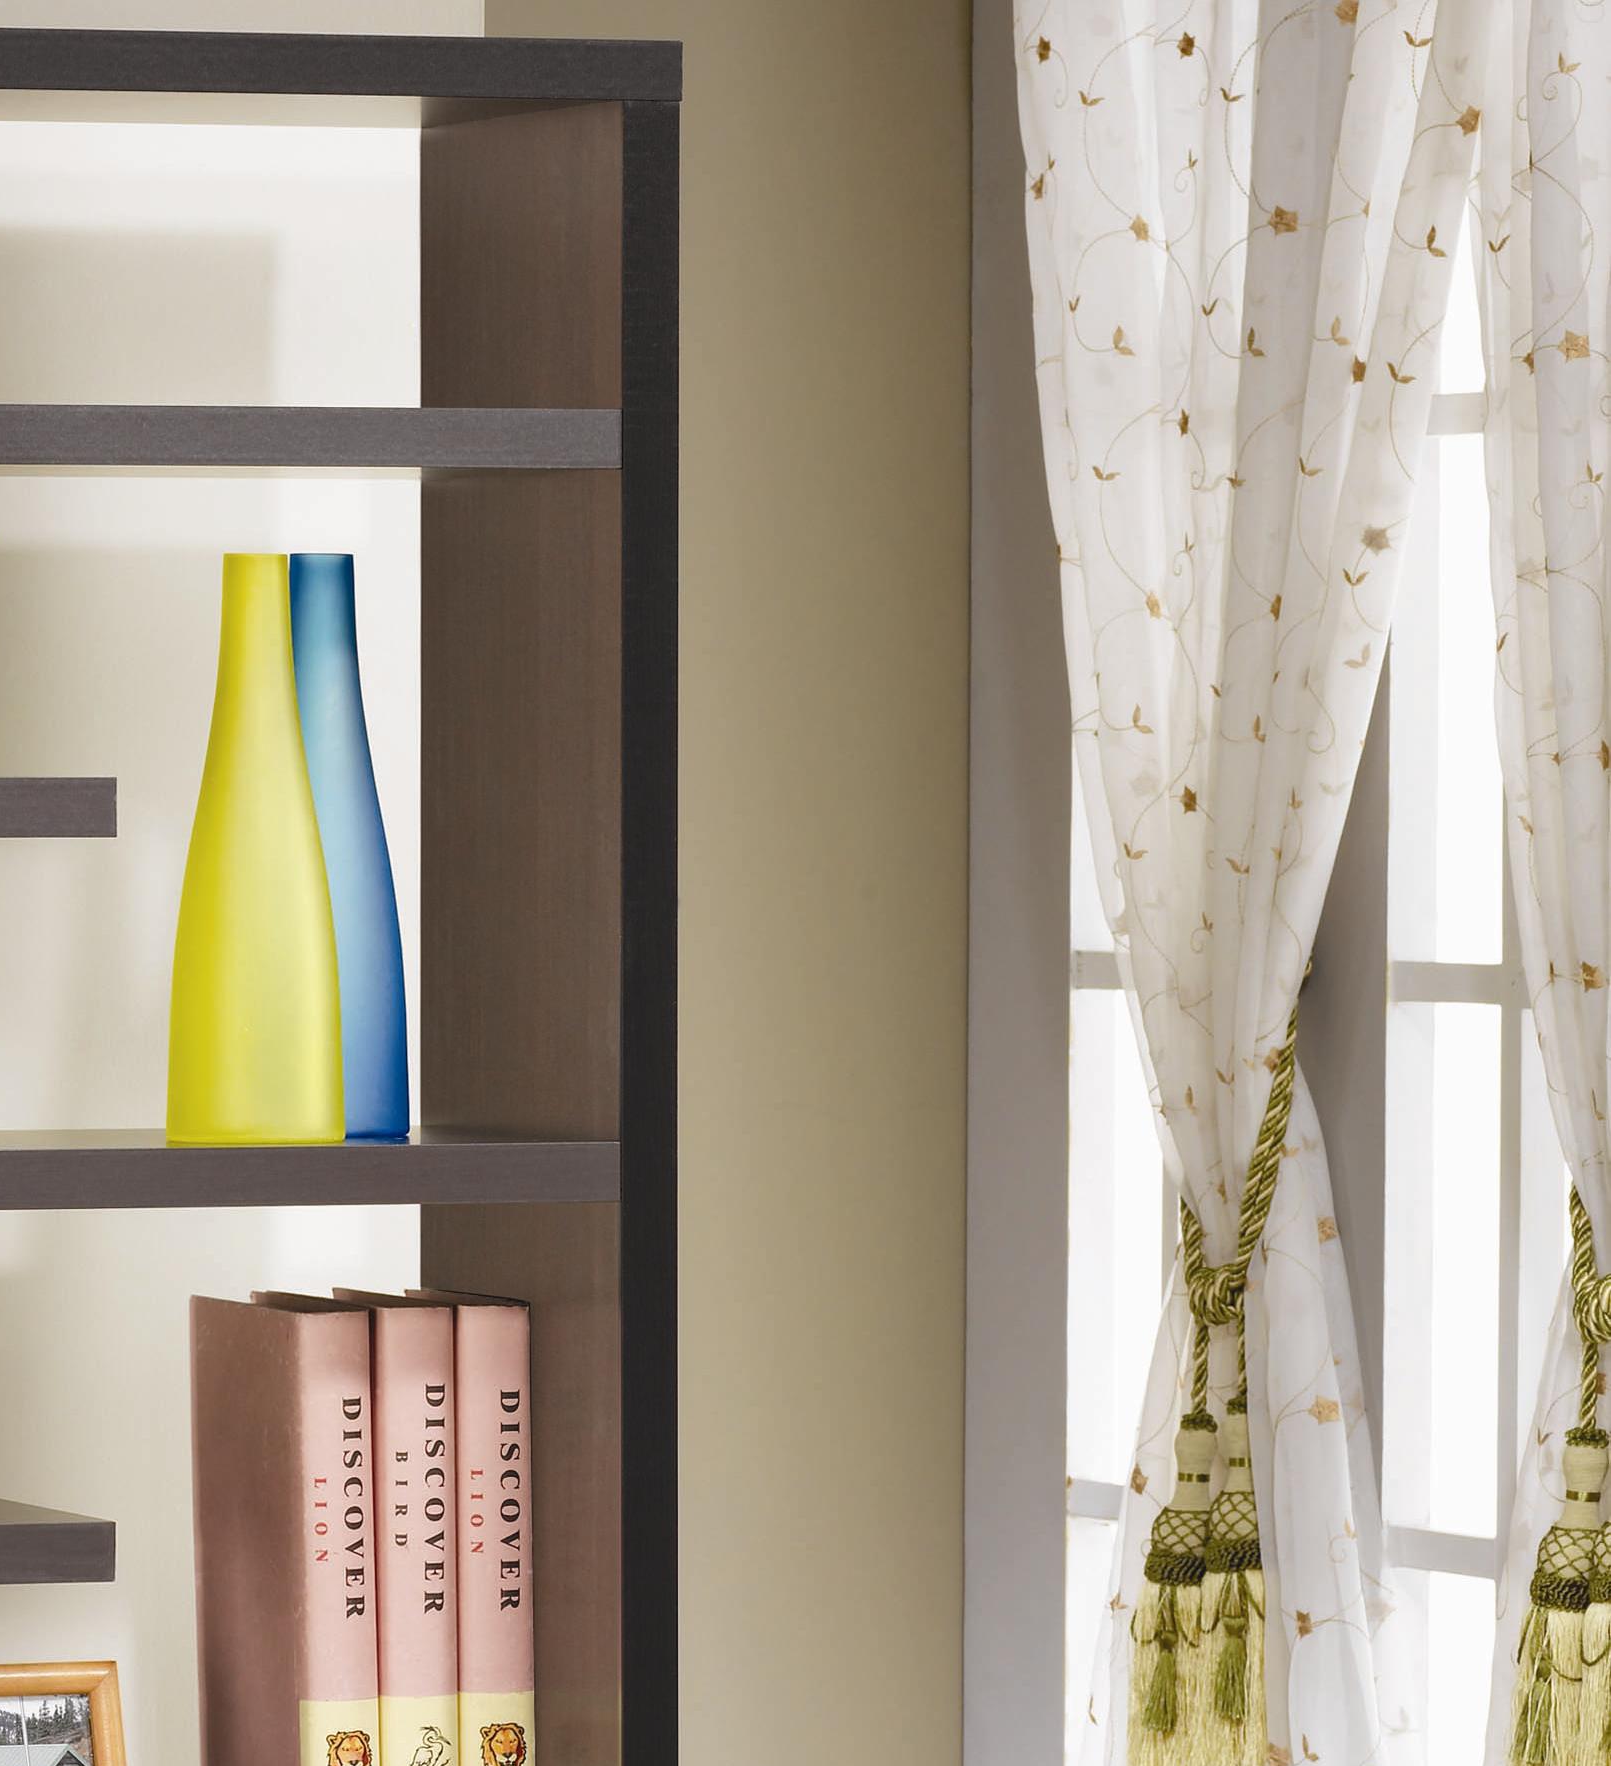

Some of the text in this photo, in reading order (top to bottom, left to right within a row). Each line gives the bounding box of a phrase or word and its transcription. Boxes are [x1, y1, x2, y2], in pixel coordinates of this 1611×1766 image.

[312, 1476, 329, 1563] LION
[341, 1395, 366, 1620] DISCOVER
[393, 1450, 409, 1548] BIRD
[423, 1383, 446, 1615] DISCOVER
[469, 1468, 485, 1554] LION
[498, 1388, 521, 1612] DISCOVER
